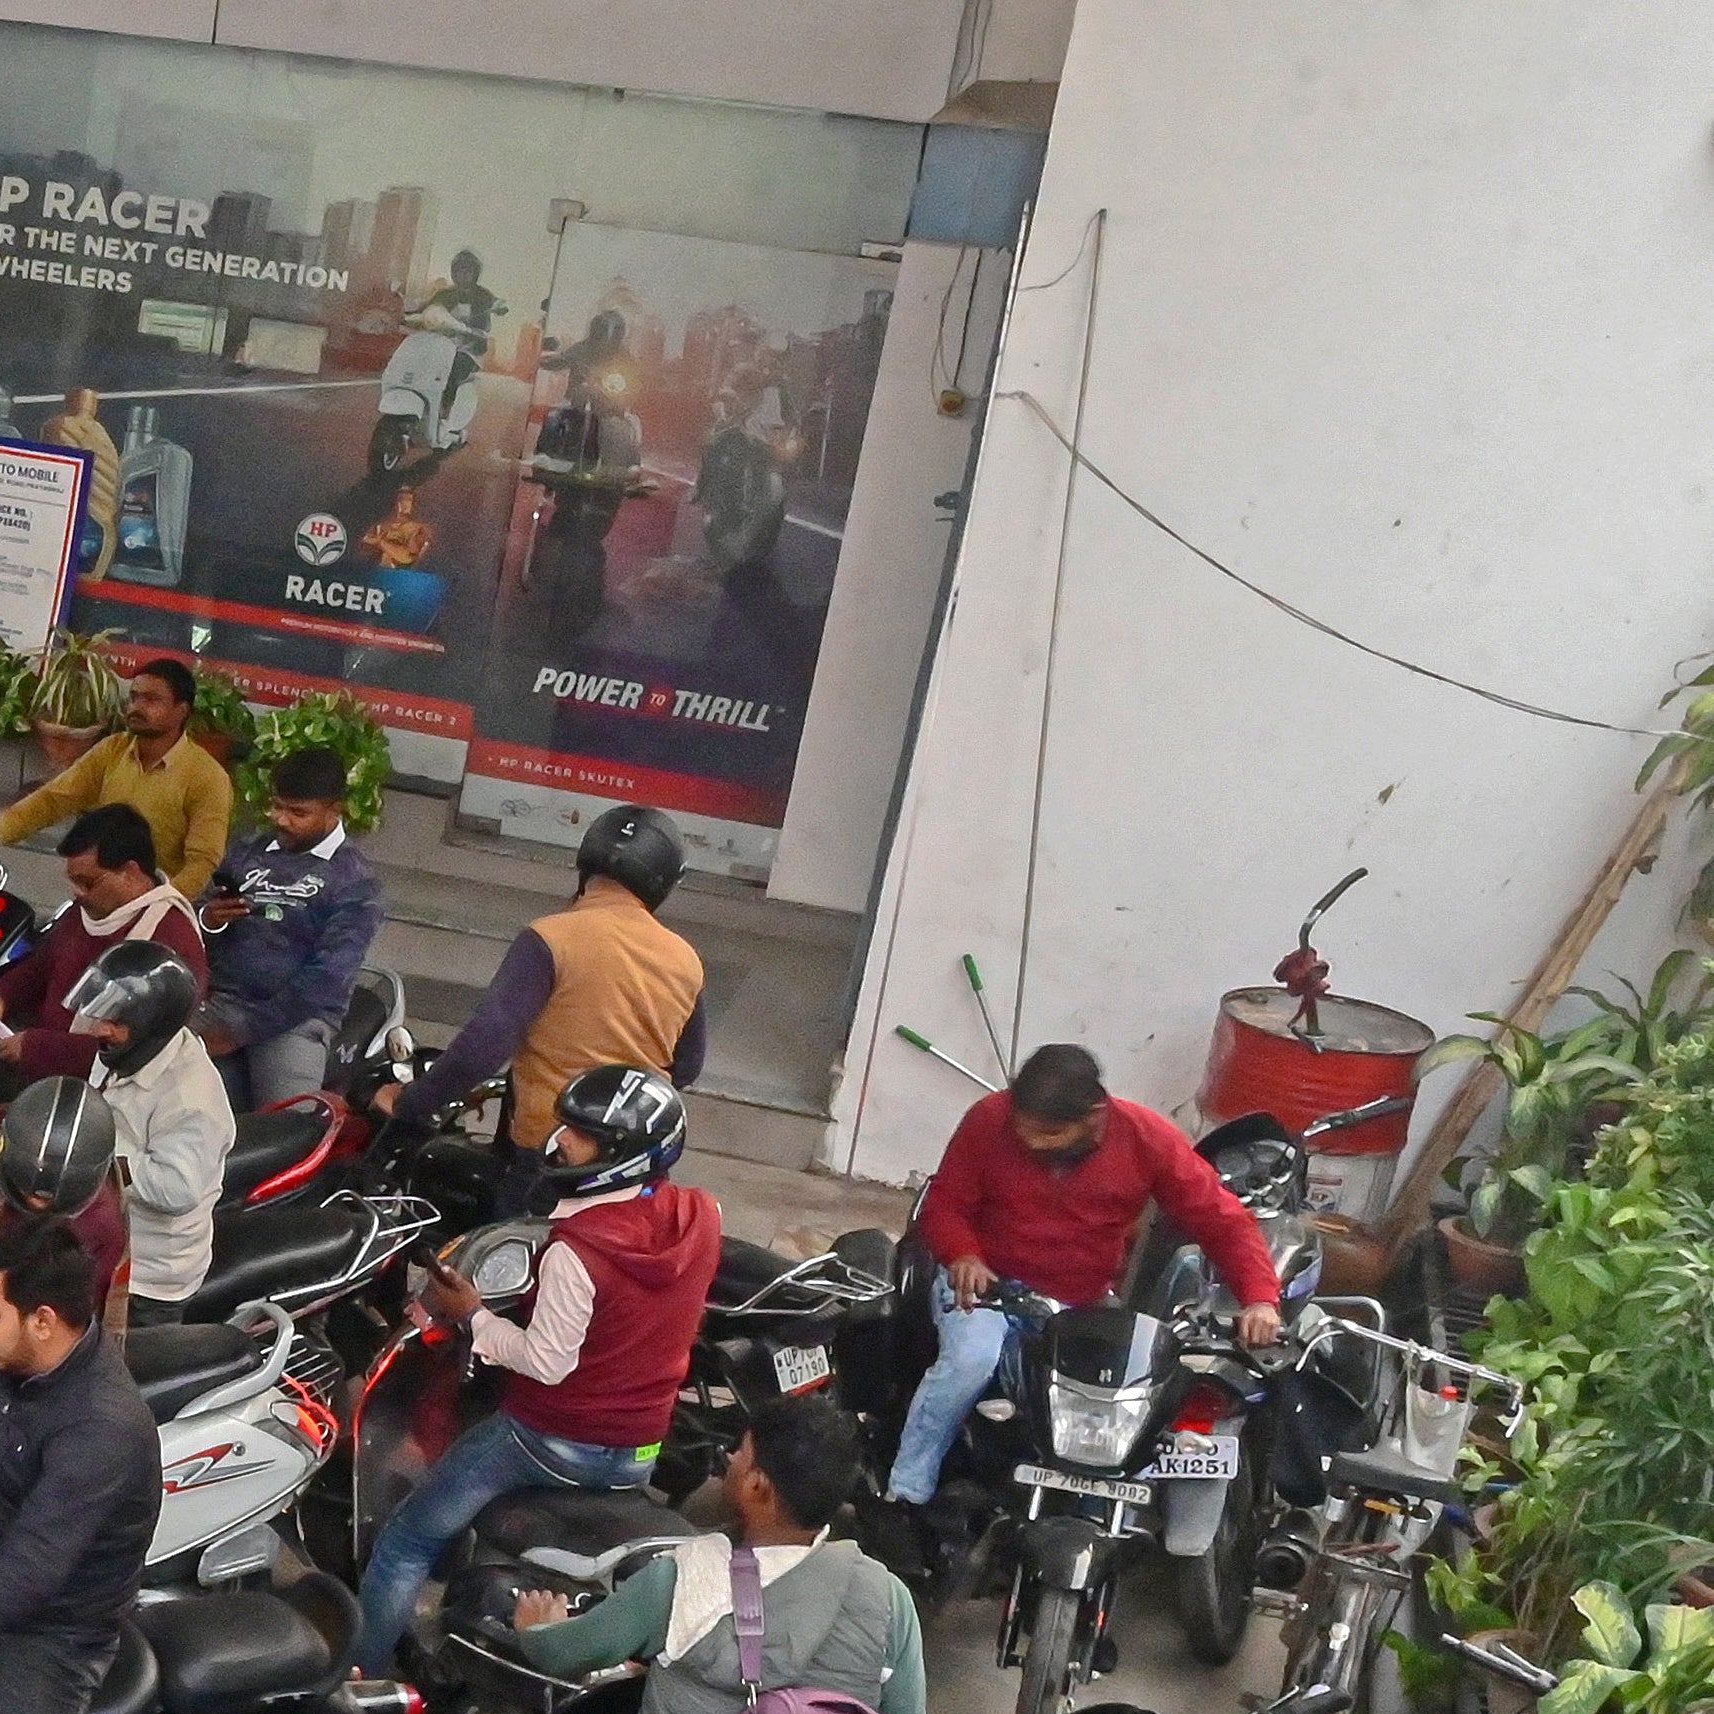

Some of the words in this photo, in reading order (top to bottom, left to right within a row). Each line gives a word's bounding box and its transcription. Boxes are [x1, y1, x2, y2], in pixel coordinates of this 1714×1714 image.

[42, 181, 211, 239] RACER
[23, 227, 76, 254] THE
[83, 234, 158, 264] NEXT
[165, 246, 350, 292] GENERATION
[18, 466, 59, 483] MOBILE
[310, 520, 338, 538] HP
[284, 574, 386, 615] RACER
[396, 706, 444, 722] RACER
[533, 666, 644, 710] POWER
[650, 692, 666, 707] TO
[672, 690, 770, 732] THRILL
[499, 757, 519, 768] HP
[524, 763, 573, 779] RACER
[578, 770, 636, 789] SKUTEX
